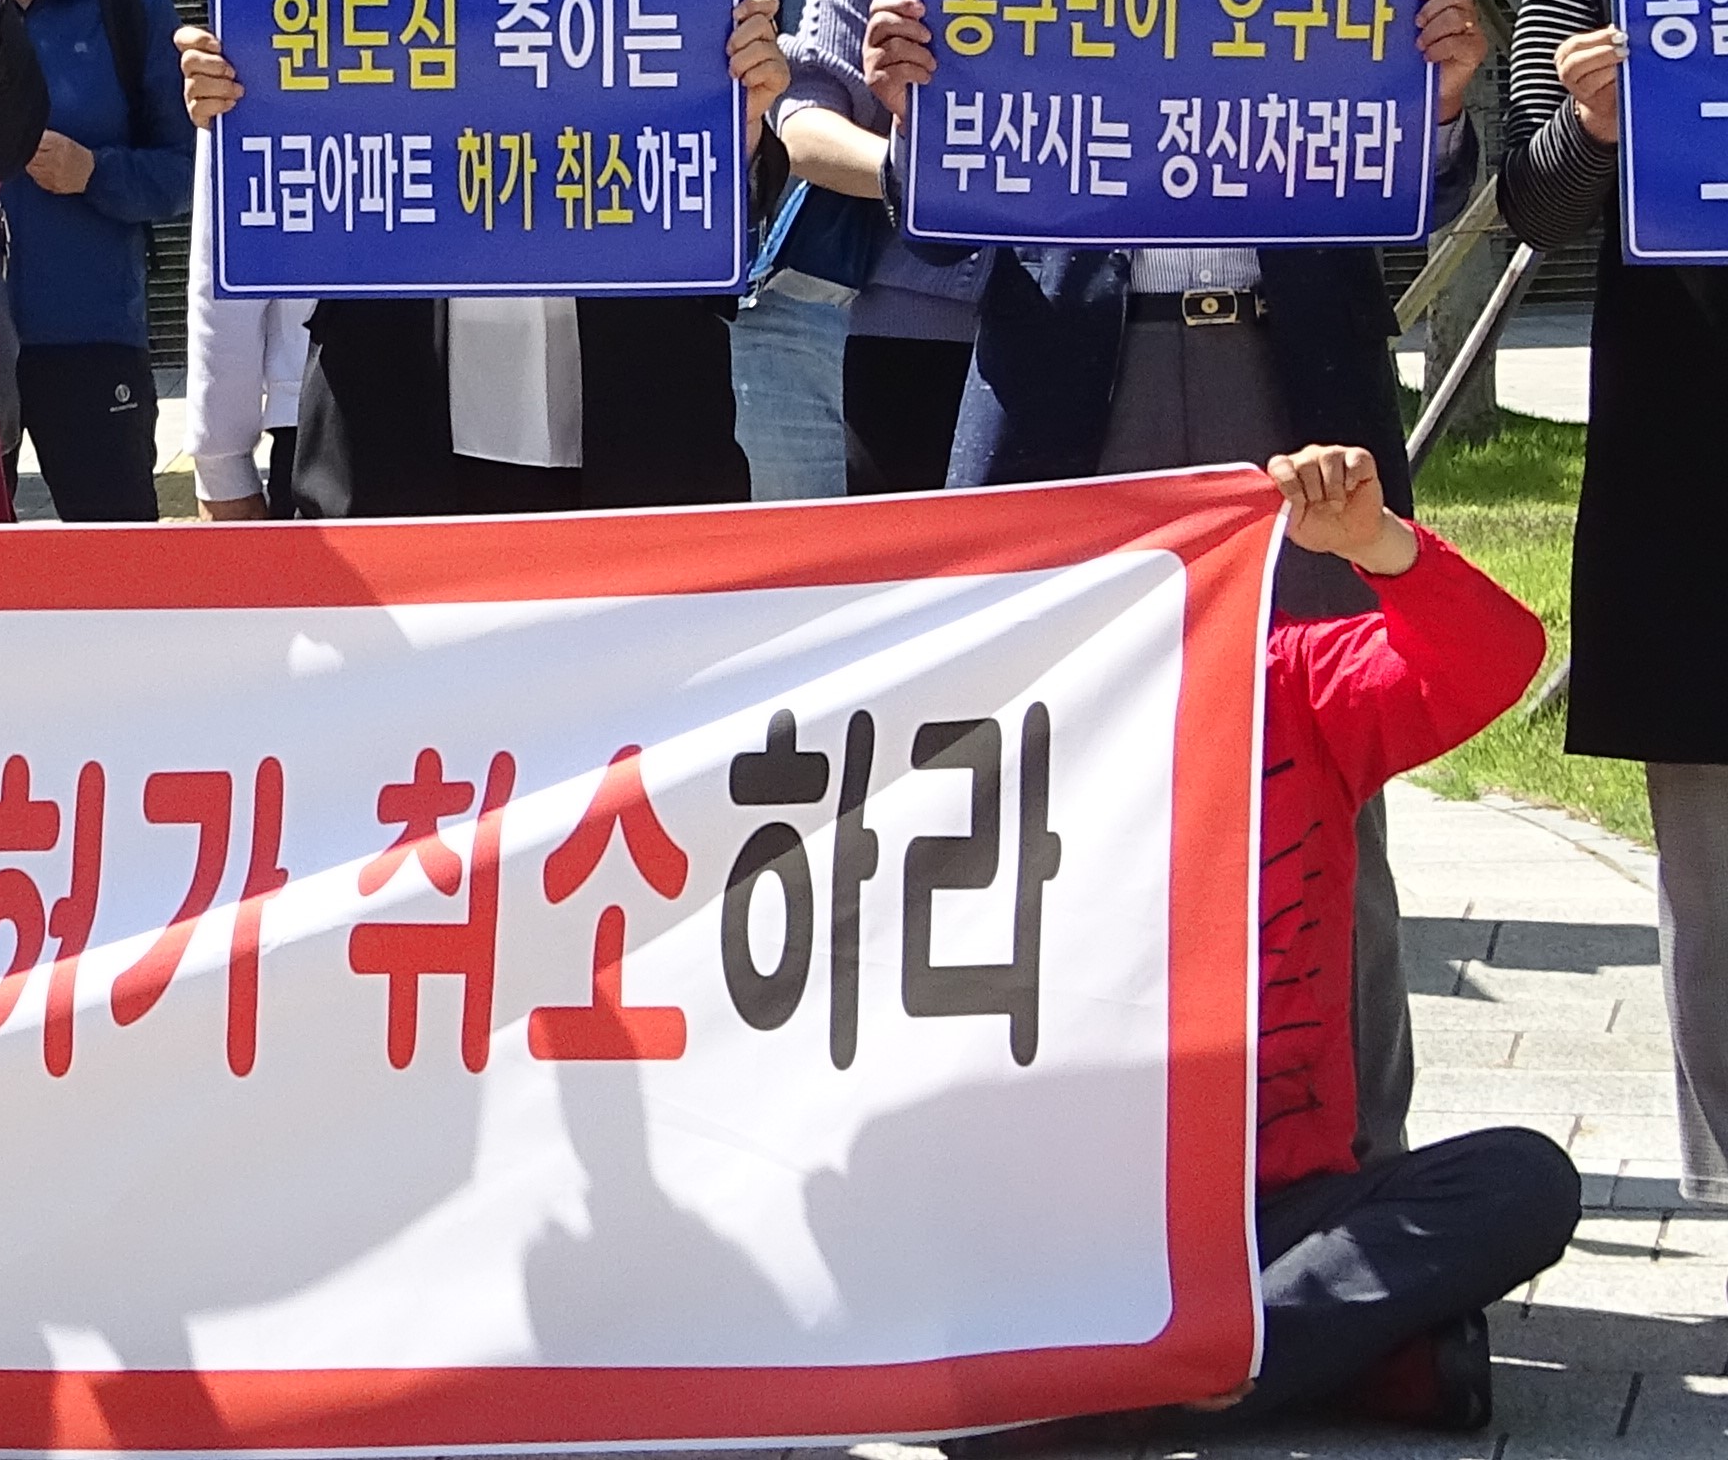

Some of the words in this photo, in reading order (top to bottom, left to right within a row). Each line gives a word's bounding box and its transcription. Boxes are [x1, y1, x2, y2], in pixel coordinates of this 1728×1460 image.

[240, 133, 437, 233] 고급아파트
[457, 127, 537, 232] 허가
[555, 125, 718, 231] 취소하라
[942, 91, 1133, 197] 부산시는
[1156, 93, 1403, 200] 정신차려라
[347, 700, 1062, 1075] 취소하라
